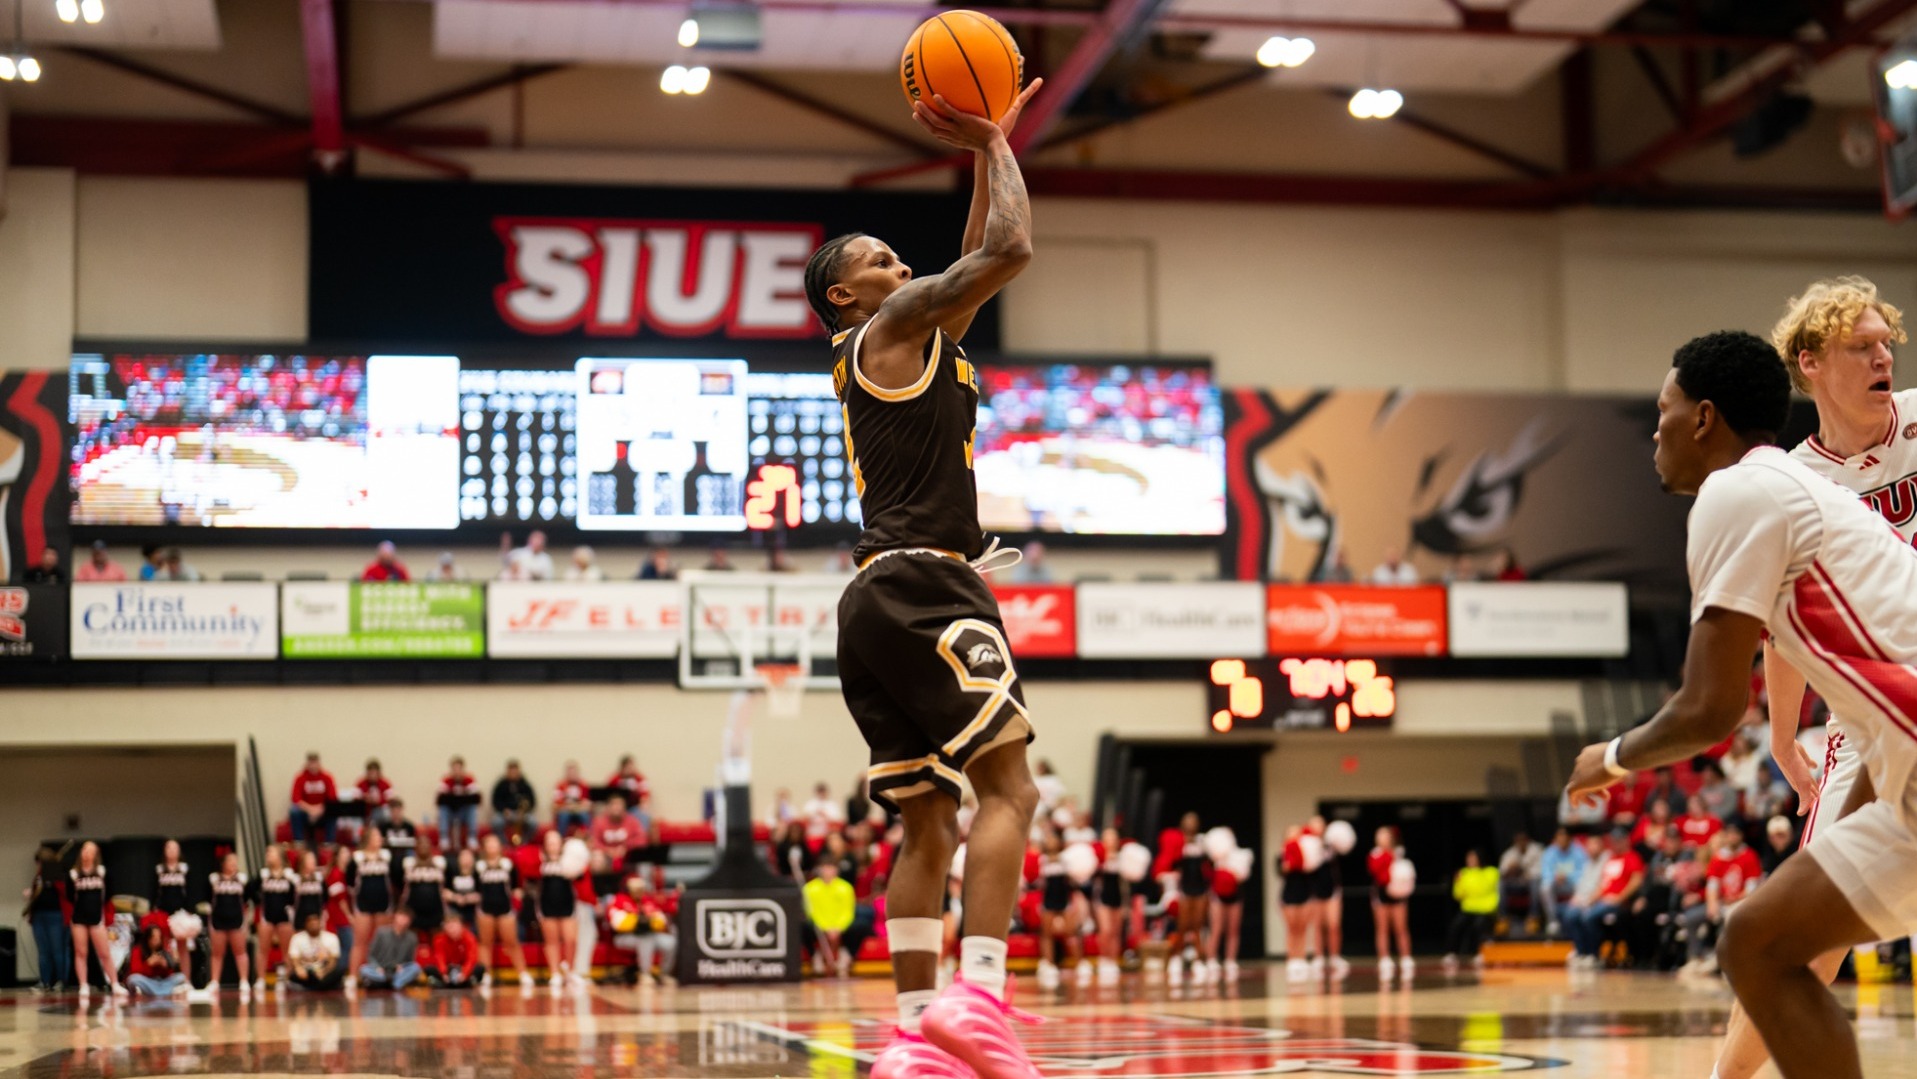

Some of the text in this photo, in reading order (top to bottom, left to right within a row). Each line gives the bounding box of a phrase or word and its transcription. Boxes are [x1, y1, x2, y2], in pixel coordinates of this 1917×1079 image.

[500, 220, 814, 333] SIUE
[955, 356, 979, 394] WE
[115, 588, 185, 614] First
[508, 600, 579, 628] JF
[83, 602, 264, 648] Community
[709, 910, 775, 949] BJC
[698, 959, 786, 978] HealthCare
